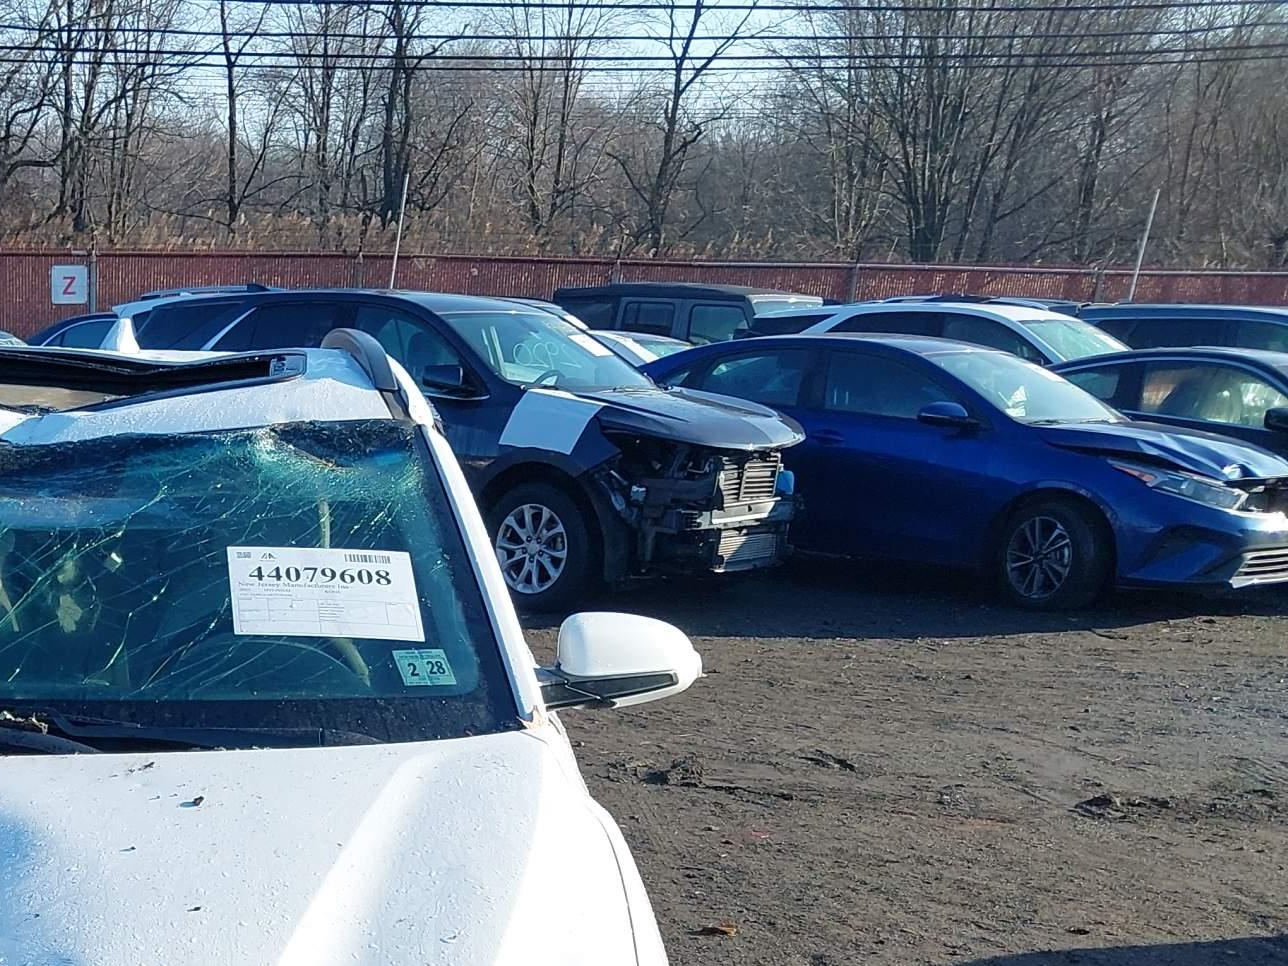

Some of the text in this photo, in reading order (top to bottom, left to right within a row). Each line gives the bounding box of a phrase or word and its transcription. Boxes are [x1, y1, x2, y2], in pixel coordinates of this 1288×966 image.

[63, 276, 76, 295] Z
[248, 565, 392, 586] 44079608
[407, 660, 446, 677] 2 28
